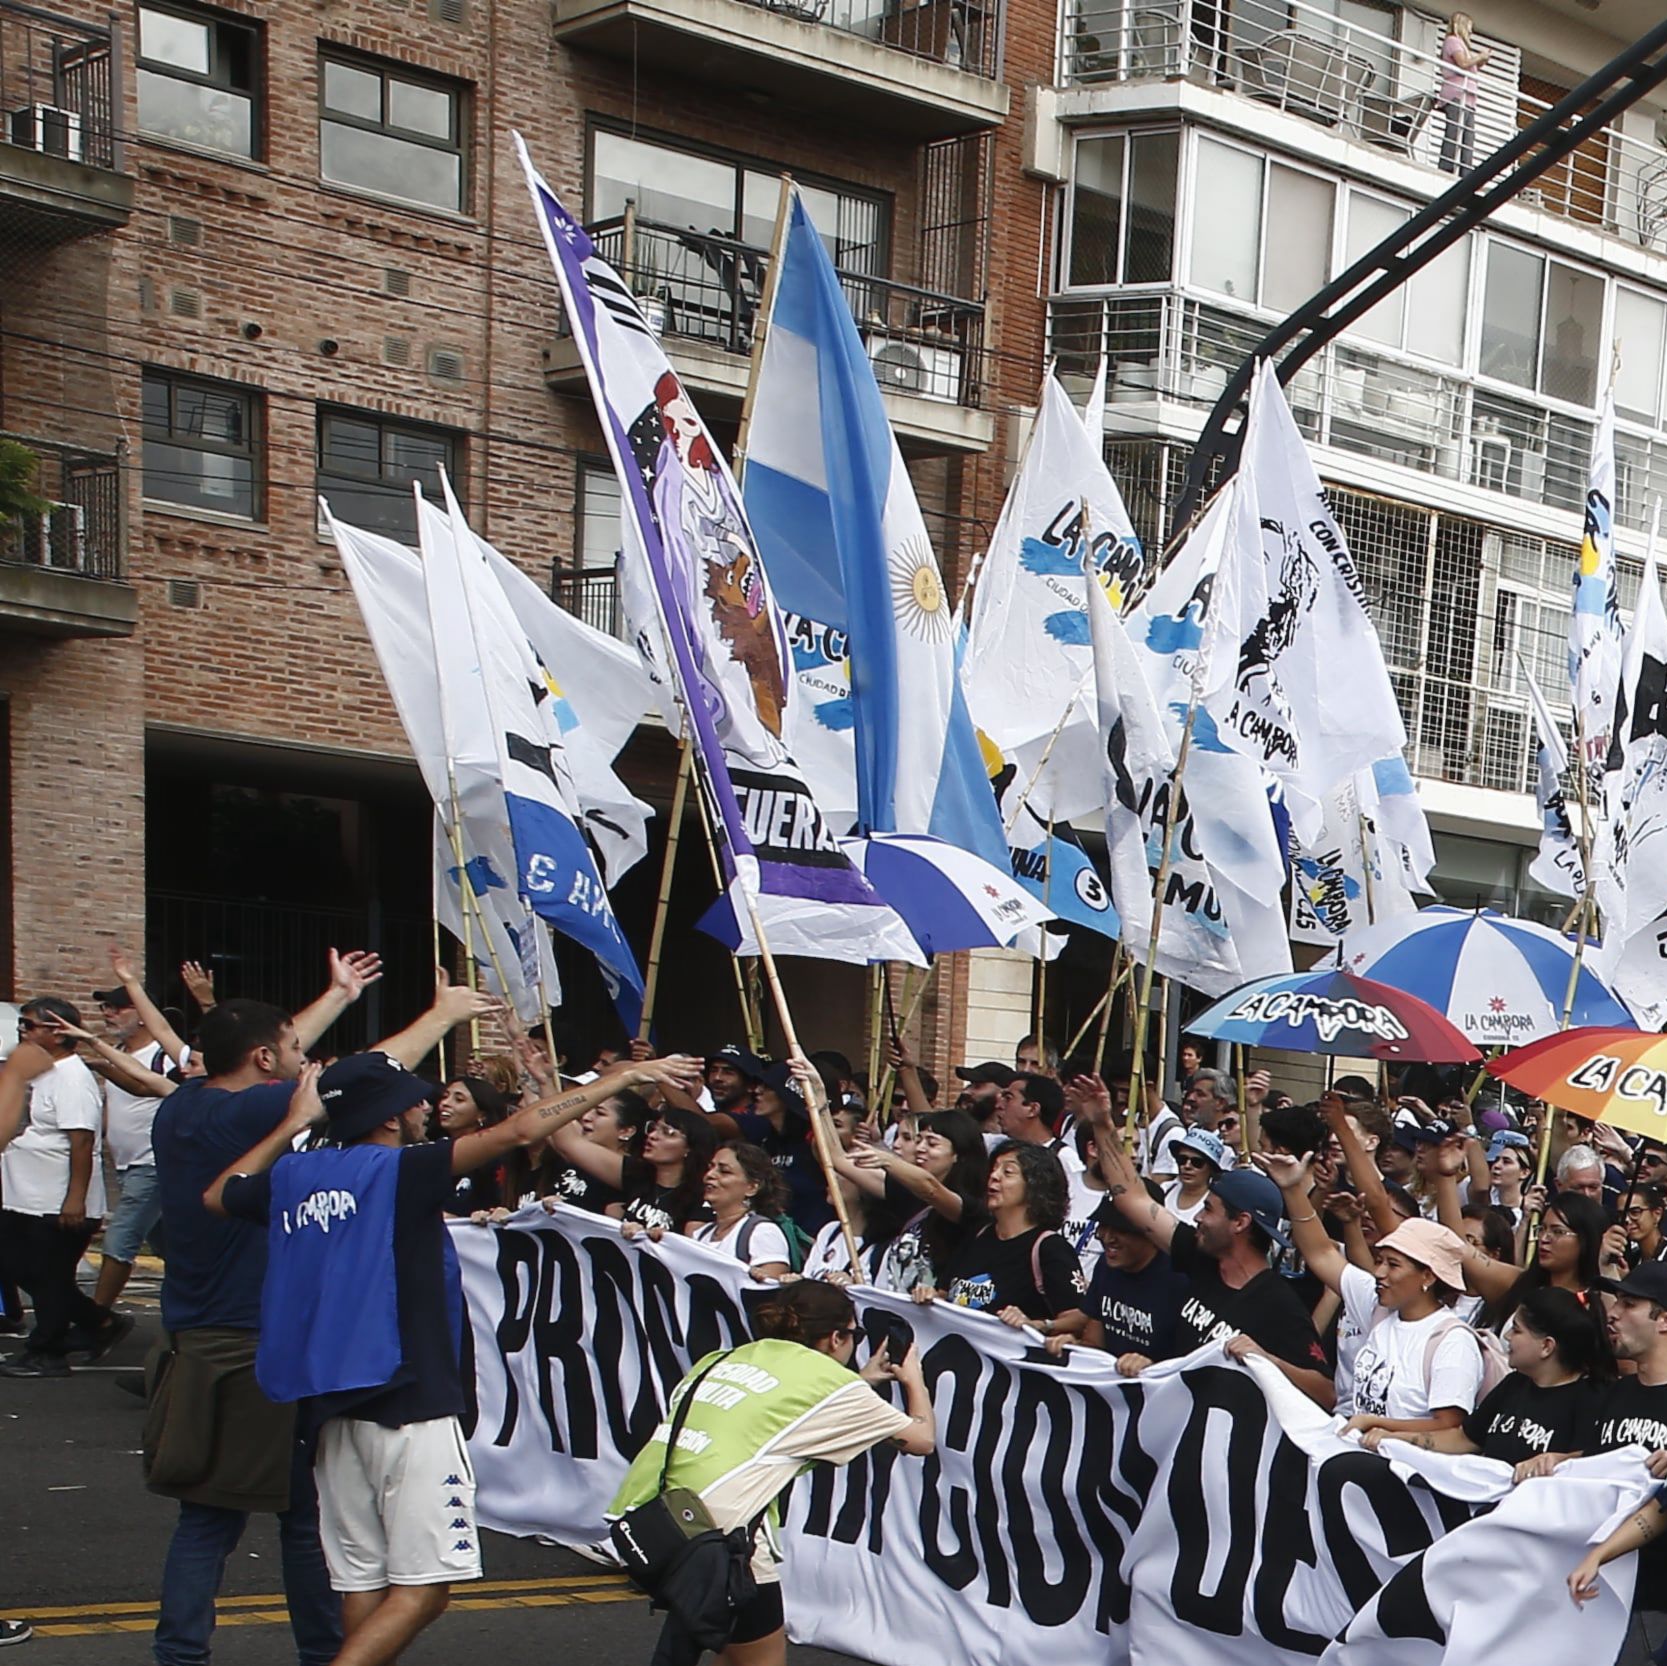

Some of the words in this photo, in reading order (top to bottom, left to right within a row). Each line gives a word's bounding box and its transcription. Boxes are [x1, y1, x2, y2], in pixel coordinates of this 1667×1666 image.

[1042, 500, 1083, 557] LA
[784, 611, 815, 651] LA
[799, 673, 838, 695] CIUDAD
[1086, 876, 1104, 901] 3
[1465, 1013, 1479, 1031] LA
[1480, 1014, 1536, 1036] CAMPORA
[1571, 1055, 1617, 1090] LA
[1101, 1295, 1113, 1318] LA
[1112, 1300, 1154, 1335] CAMPORA
[1601, 1418, 1616, 1445] LA
[618, 1520, 649, 1565] Champion
